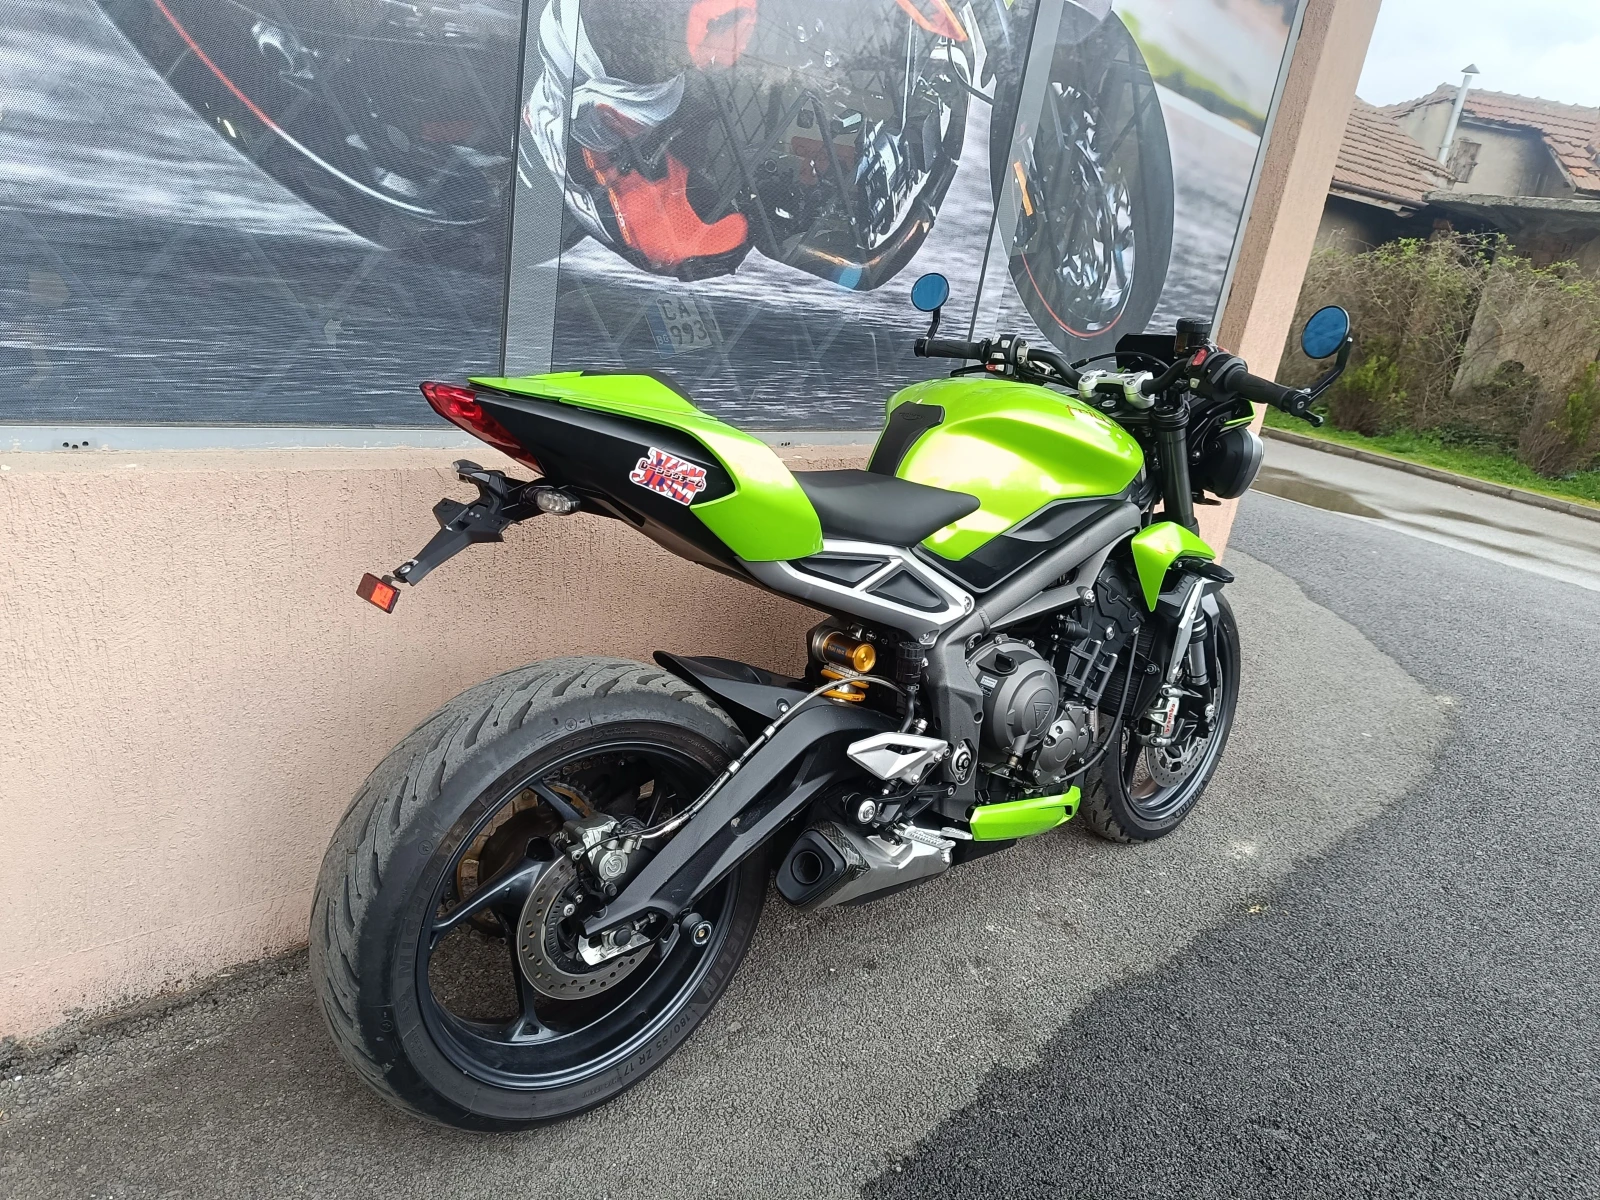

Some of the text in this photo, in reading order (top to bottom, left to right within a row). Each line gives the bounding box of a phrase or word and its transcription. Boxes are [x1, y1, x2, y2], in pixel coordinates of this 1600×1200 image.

[660, 299, 692, 320] CA
[670, 320, 708, 345] 993
[1165, 703, 1176, 734] brembo
[1176, 781, 1205, 817] MICHELIN
[656, 1013, 691, 1051] 180/55
[623, 1063, 635, 1076] 17
[638, 1049, 654, 1065] ZR
